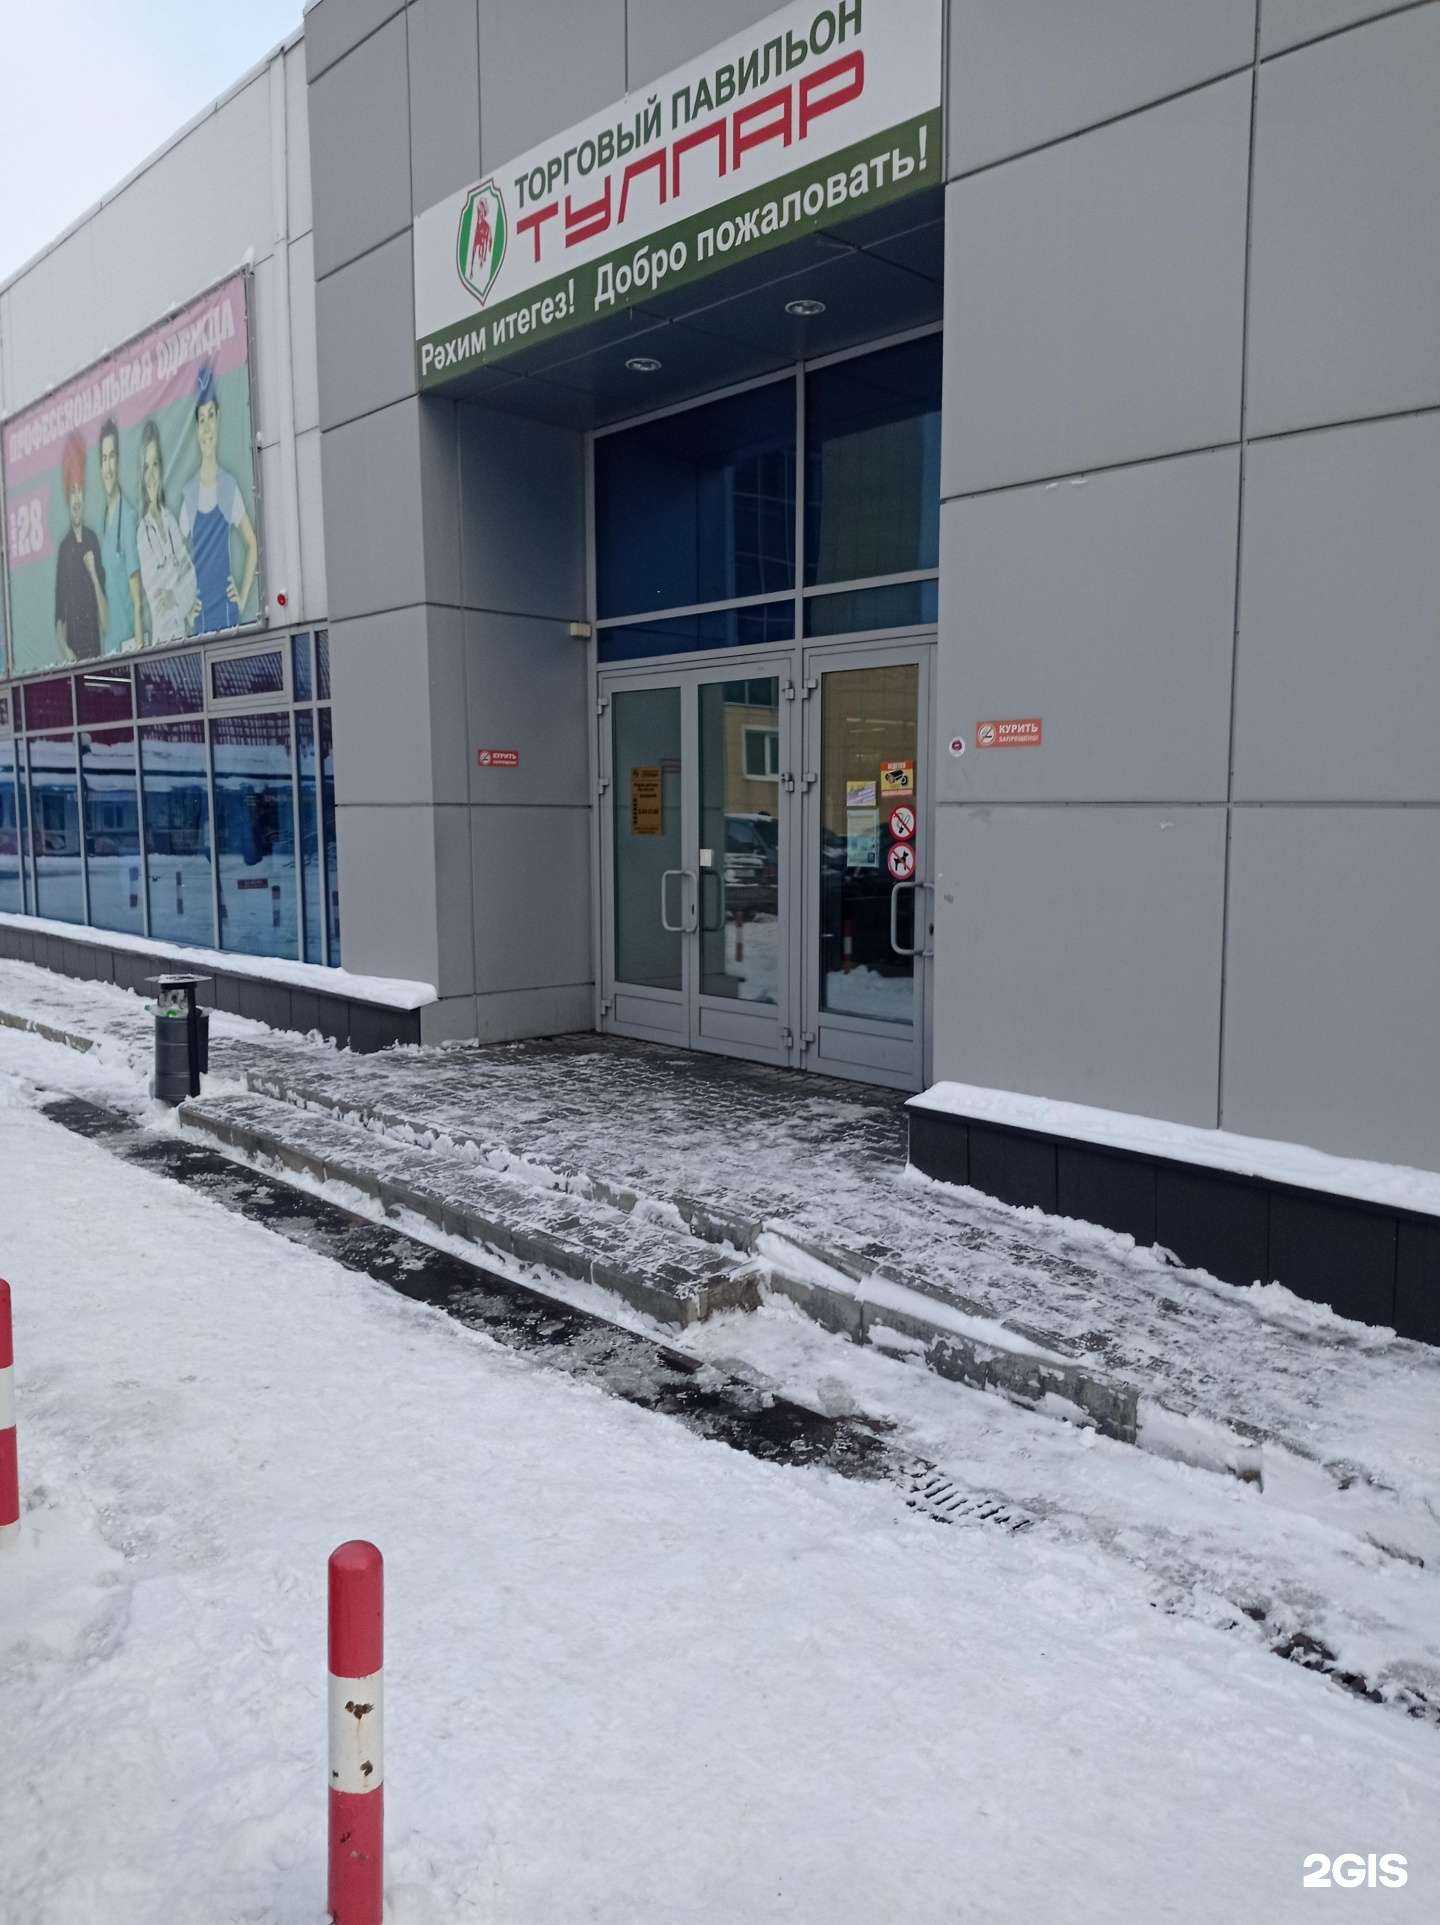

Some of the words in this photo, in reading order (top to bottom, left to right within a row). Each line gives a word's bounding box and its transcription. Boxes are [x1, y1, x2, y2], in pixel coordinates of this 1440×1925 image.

[515, 95, 662, 208] ТОРГОВЫЙ
[671, 0, 862, 130] ПАВИЛЬОН
[516, 49, 865, 263] ТУЛПАР
[421, 329, 487, 376] Рәхим
[493, 278, 576, 347] итегез!
[594, 245, 687, 312] Добро
[697, 125, 928, 262] пожаловать!
[999, 723, 1039, 734] КУРИТЬ
